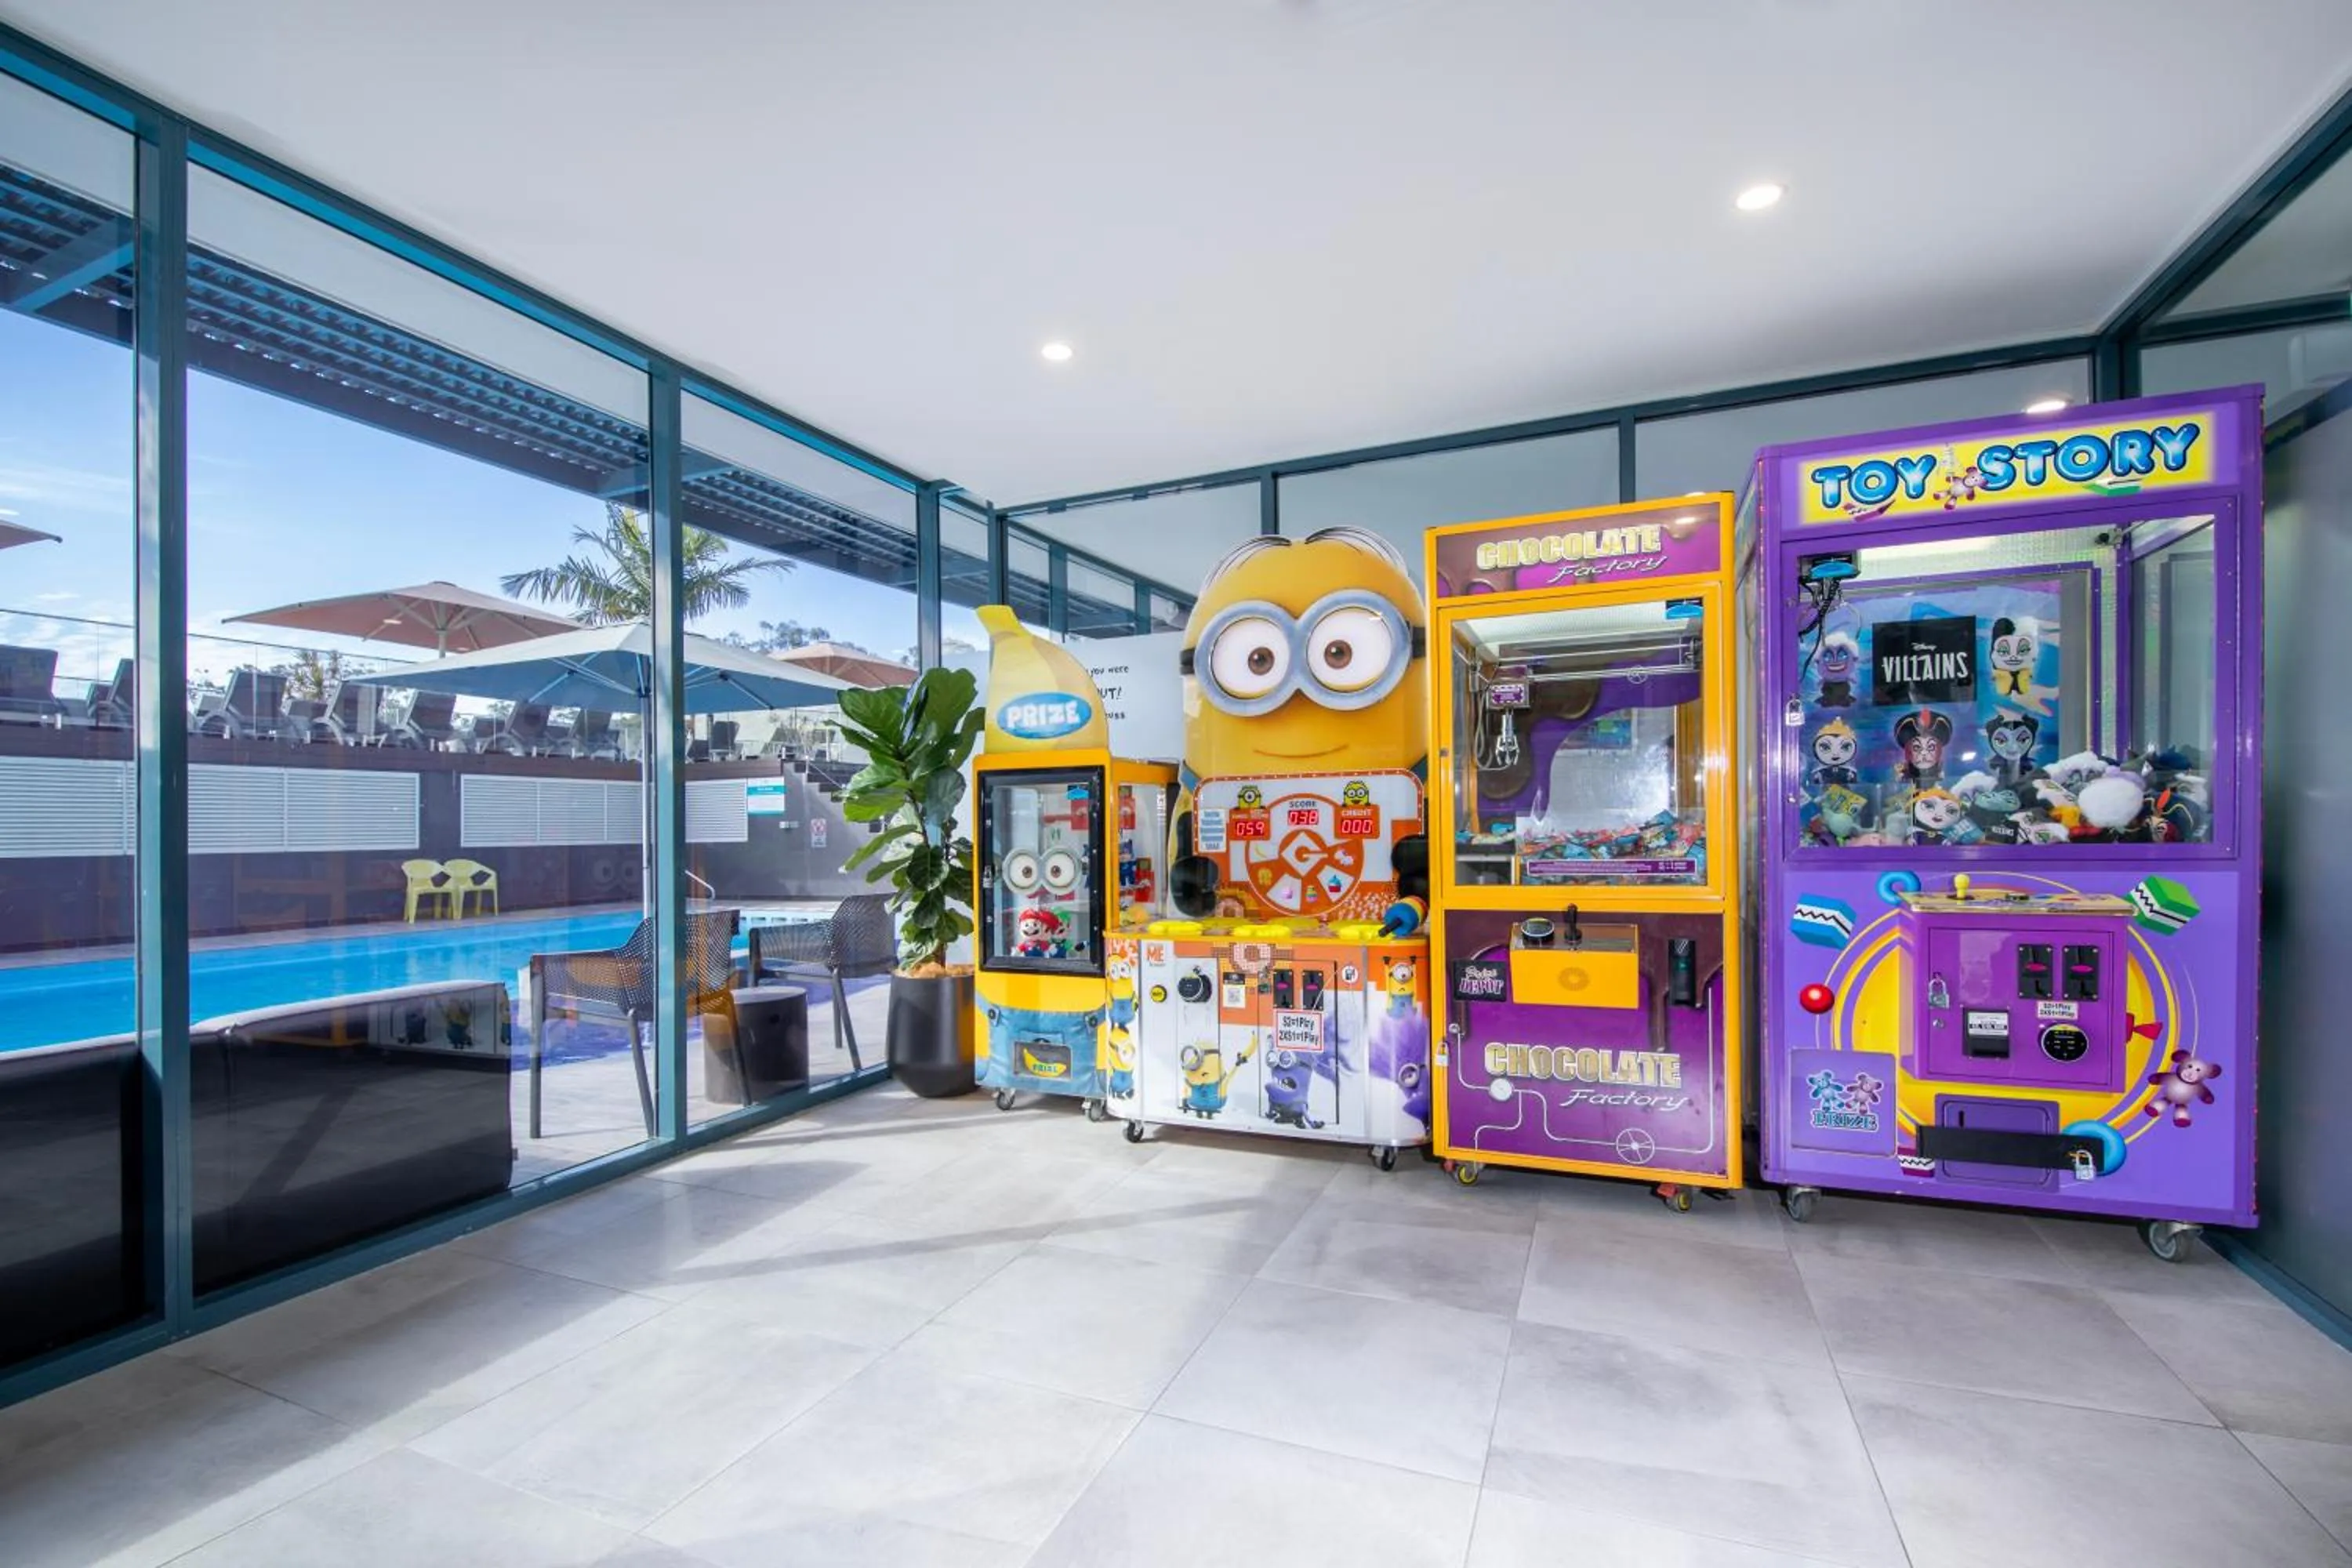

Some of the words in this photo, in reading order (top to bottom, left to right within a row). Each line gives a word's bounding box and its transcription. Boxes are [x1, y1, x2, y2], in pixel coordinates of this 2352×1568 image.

[1811, 455, 1936, 508] TOY
[1977, 423, 2200, 492] STORY
[1476, 524, 1661, 570] CHOCOLATE
[1546, 555, 1668, 583] Factory
[1882, 652, 1969, 682] VILLAINS
[1097, 685, 1123, 700] UT!
[1007, 700, 1080, 728] PRIZE
[1236, 821, 1265, 836] 059
[1288, 811, 1318, 825] 038
[1341, 819, 1373, 833] 000
[1484, 1042, 1682, 1089] CHOCOLATE
[1559, 1088, 1689, 1112] Factory
